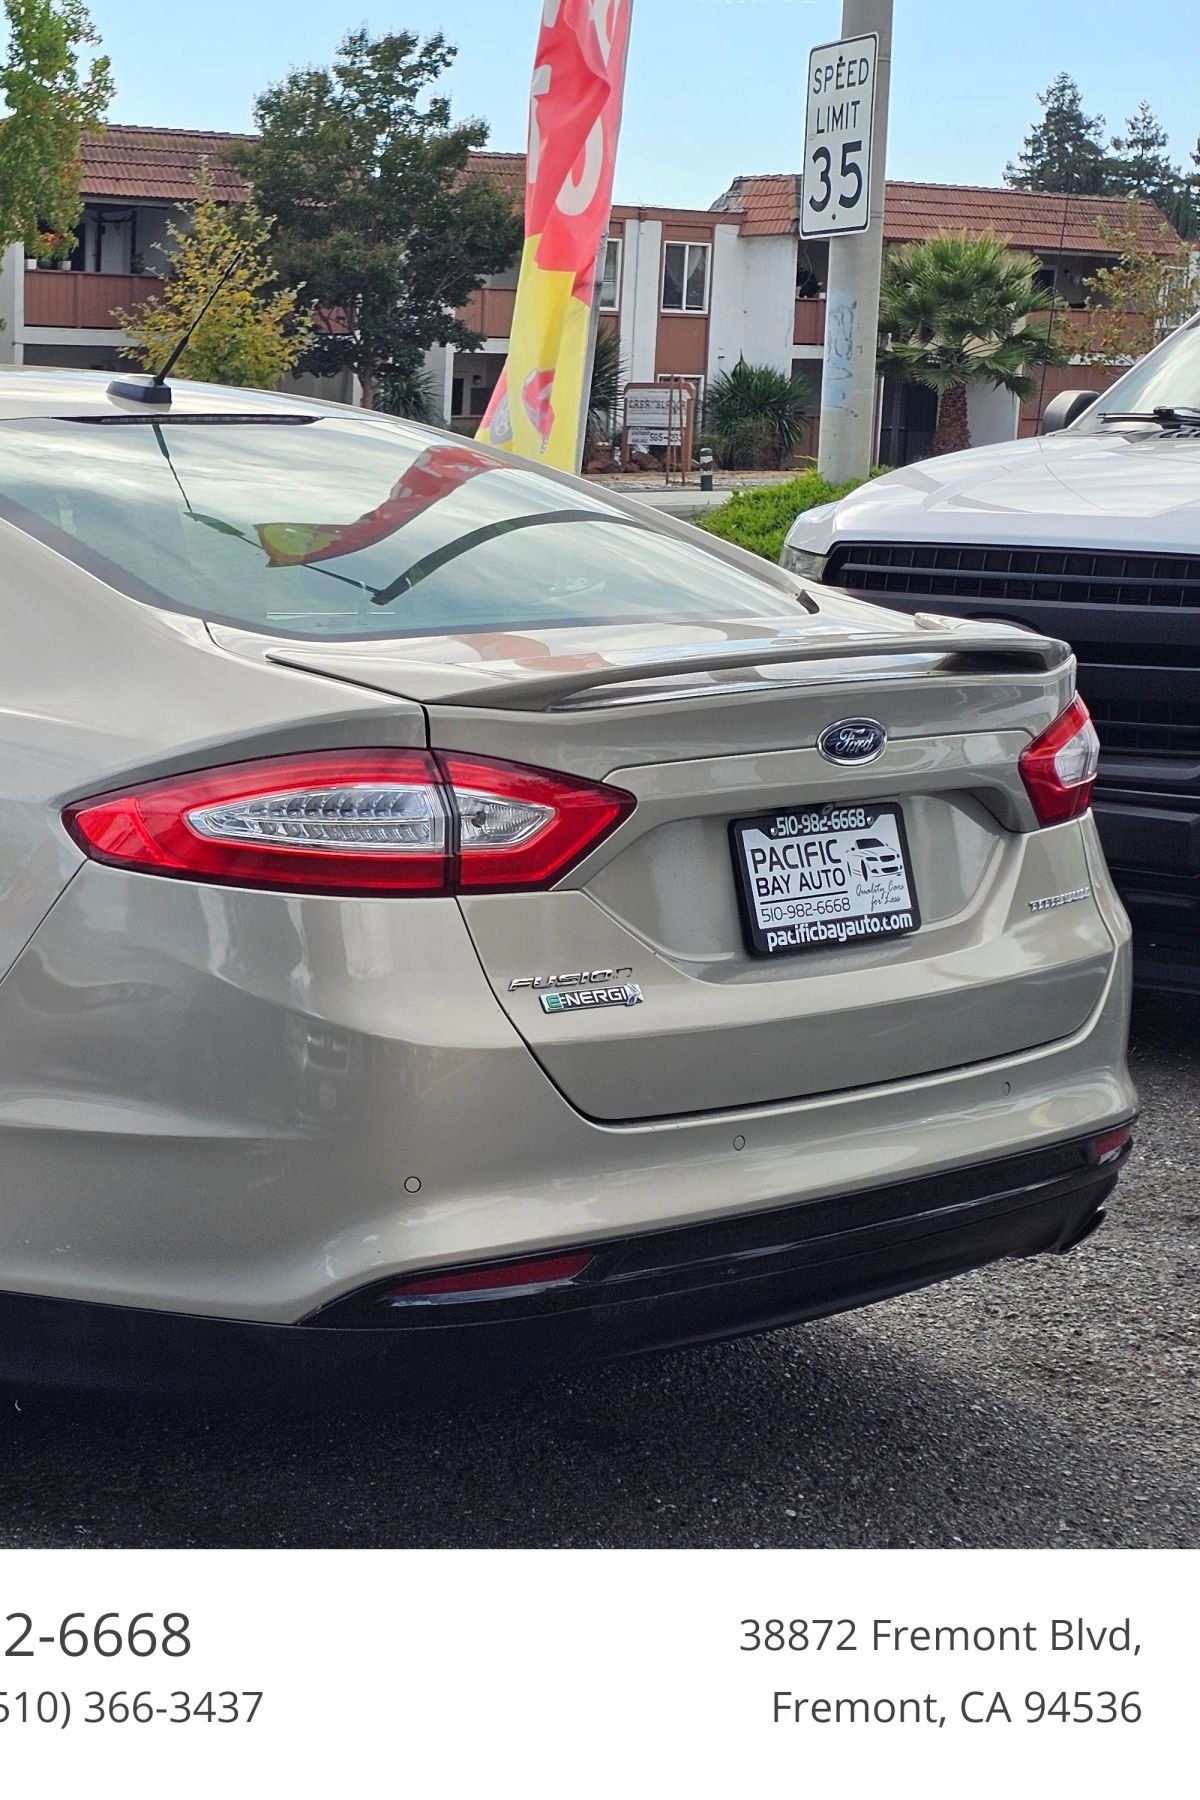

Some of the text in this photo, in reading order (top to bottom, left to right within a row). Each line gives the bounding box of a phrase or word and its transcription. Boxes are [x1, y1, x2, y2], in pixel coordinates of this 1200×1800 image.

[813, 57, 870, 95] SPEED
[816, 100, 861, 135] LIMIT
[809, 140, 863, 213] 35
[835, 728, 875, 755] Ford
[776, 808, 866, 837] 510-982-6668
[750, 839, 842, 875] PACIFIC
[755, 867, 846, 898] BAY AUTO
[761, 897, 851, 923] 510-982-6668
[766, 912, 913, 952] pacificbayauto.com
[508, 967, 633, 992] FUSION
[545, 987, 628, 1010] ENERGI
